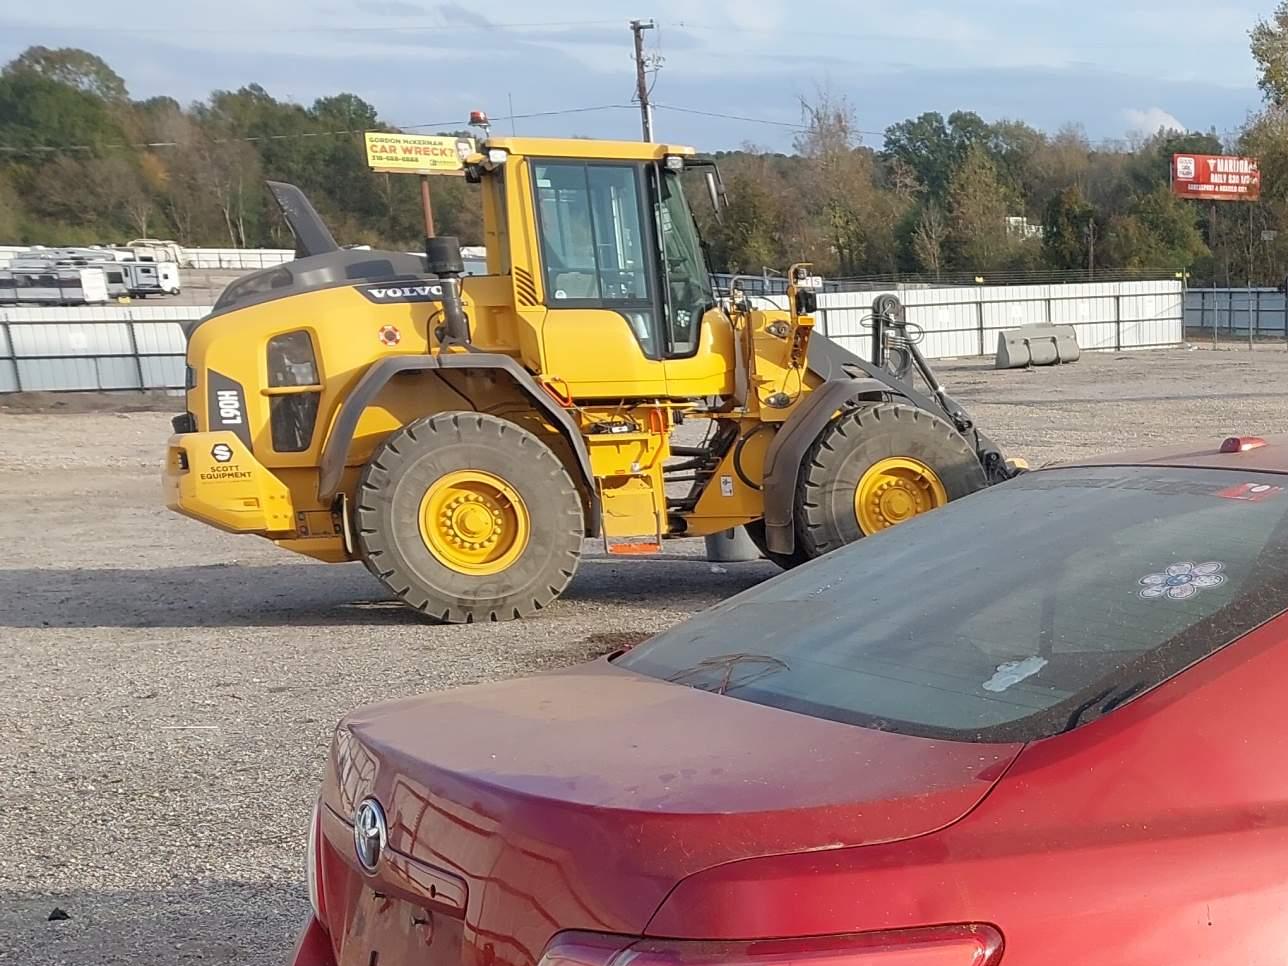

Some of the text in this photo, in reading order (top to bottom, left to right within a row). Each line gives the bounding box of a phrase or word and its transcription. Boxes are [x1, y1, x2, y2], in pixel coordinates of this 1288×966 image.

[369, 144, 454, 157] CAR WRECK?
[367, 285, 443, 298] VOLVO
[216, 390, 242, 424] L90H
[210, 464, 240, 473] SCOTT
[200, 471, 252, 480] EQUIPMENT
